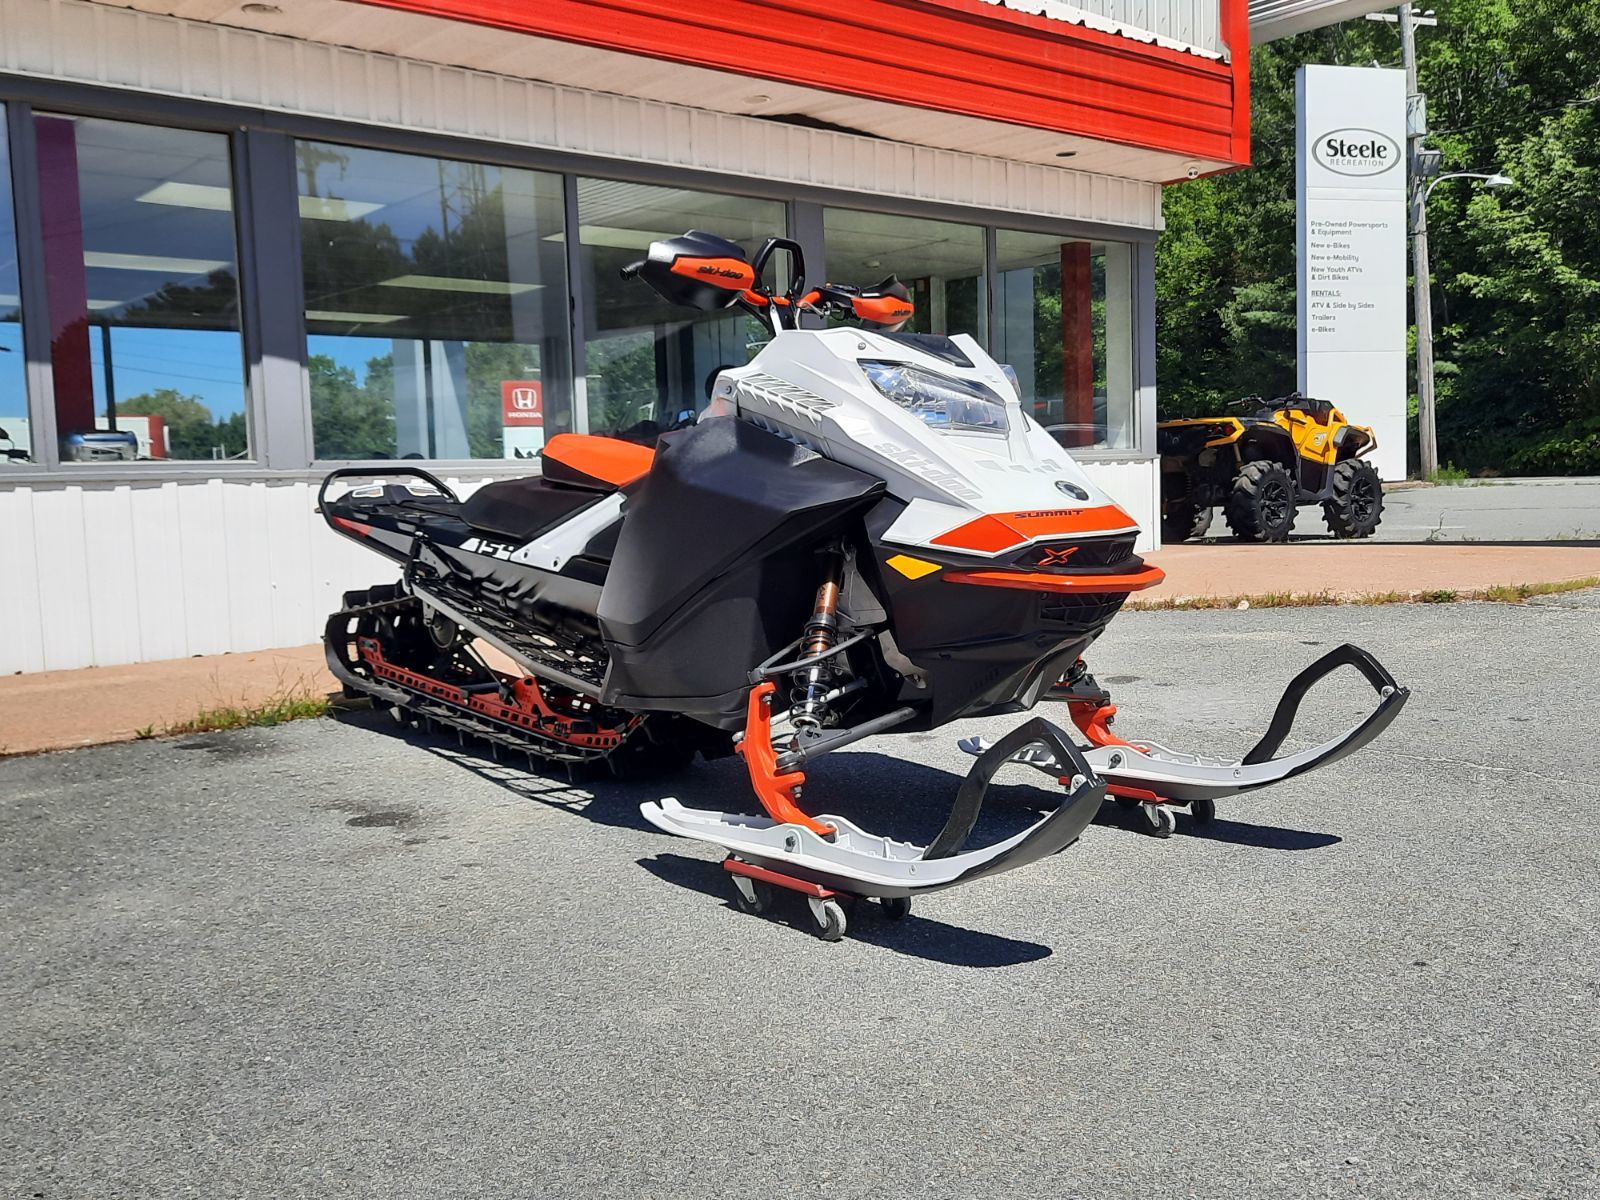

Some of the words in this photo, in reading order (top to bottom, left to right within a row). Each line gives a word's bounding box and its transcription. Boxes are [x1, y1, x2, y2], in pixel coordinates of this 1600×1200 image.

[1326, 138, 1387, 159] Steele
[1330, 158, 1384, 167] RECREATION
[1348, 221, 1388, 230] Powersports
[1310, 241, 1325, 249] New
[1326, 254, 1359, 262] e-Mobility
[1347, 302, 1357, 310] by
[1014, 509, 1084, 519] SUMMIT
